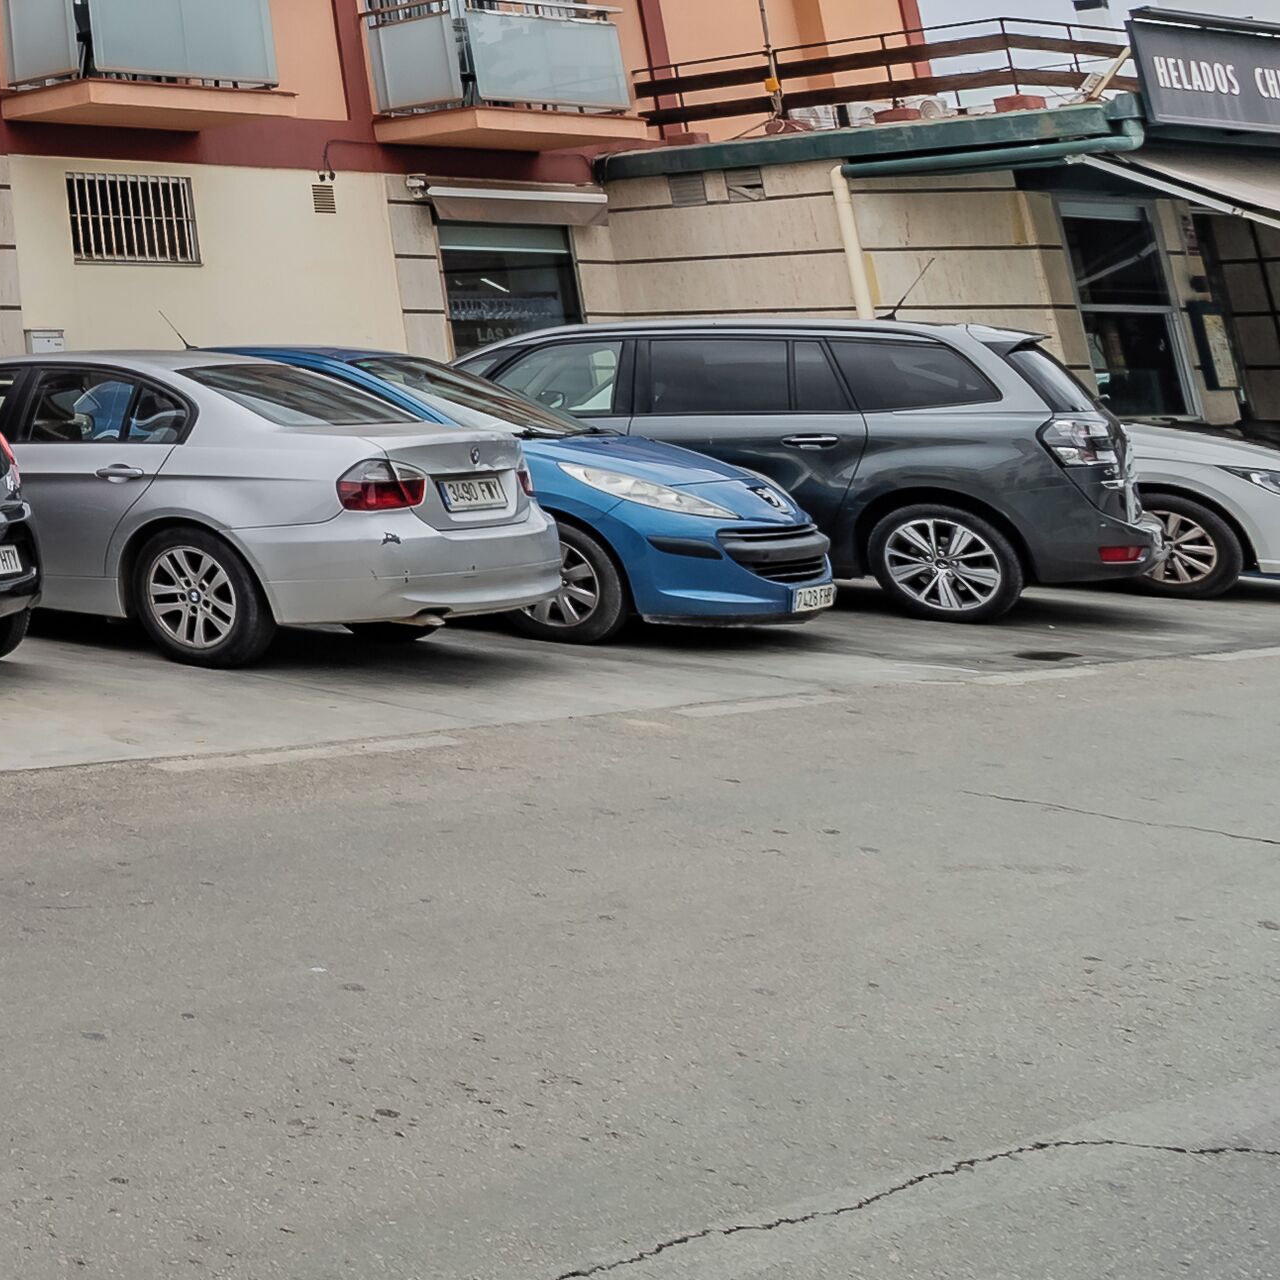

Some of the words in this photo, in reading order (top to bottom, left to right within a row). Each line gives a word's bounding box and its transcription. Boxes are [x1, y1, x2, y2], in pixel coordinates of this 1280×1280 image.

[1154, 56, 1240, 95] HELADOS
[1255, 67, 1280, 99] CH
[448, 482, 478, 502] 3490
[0, 549, 19, 570] HTY
